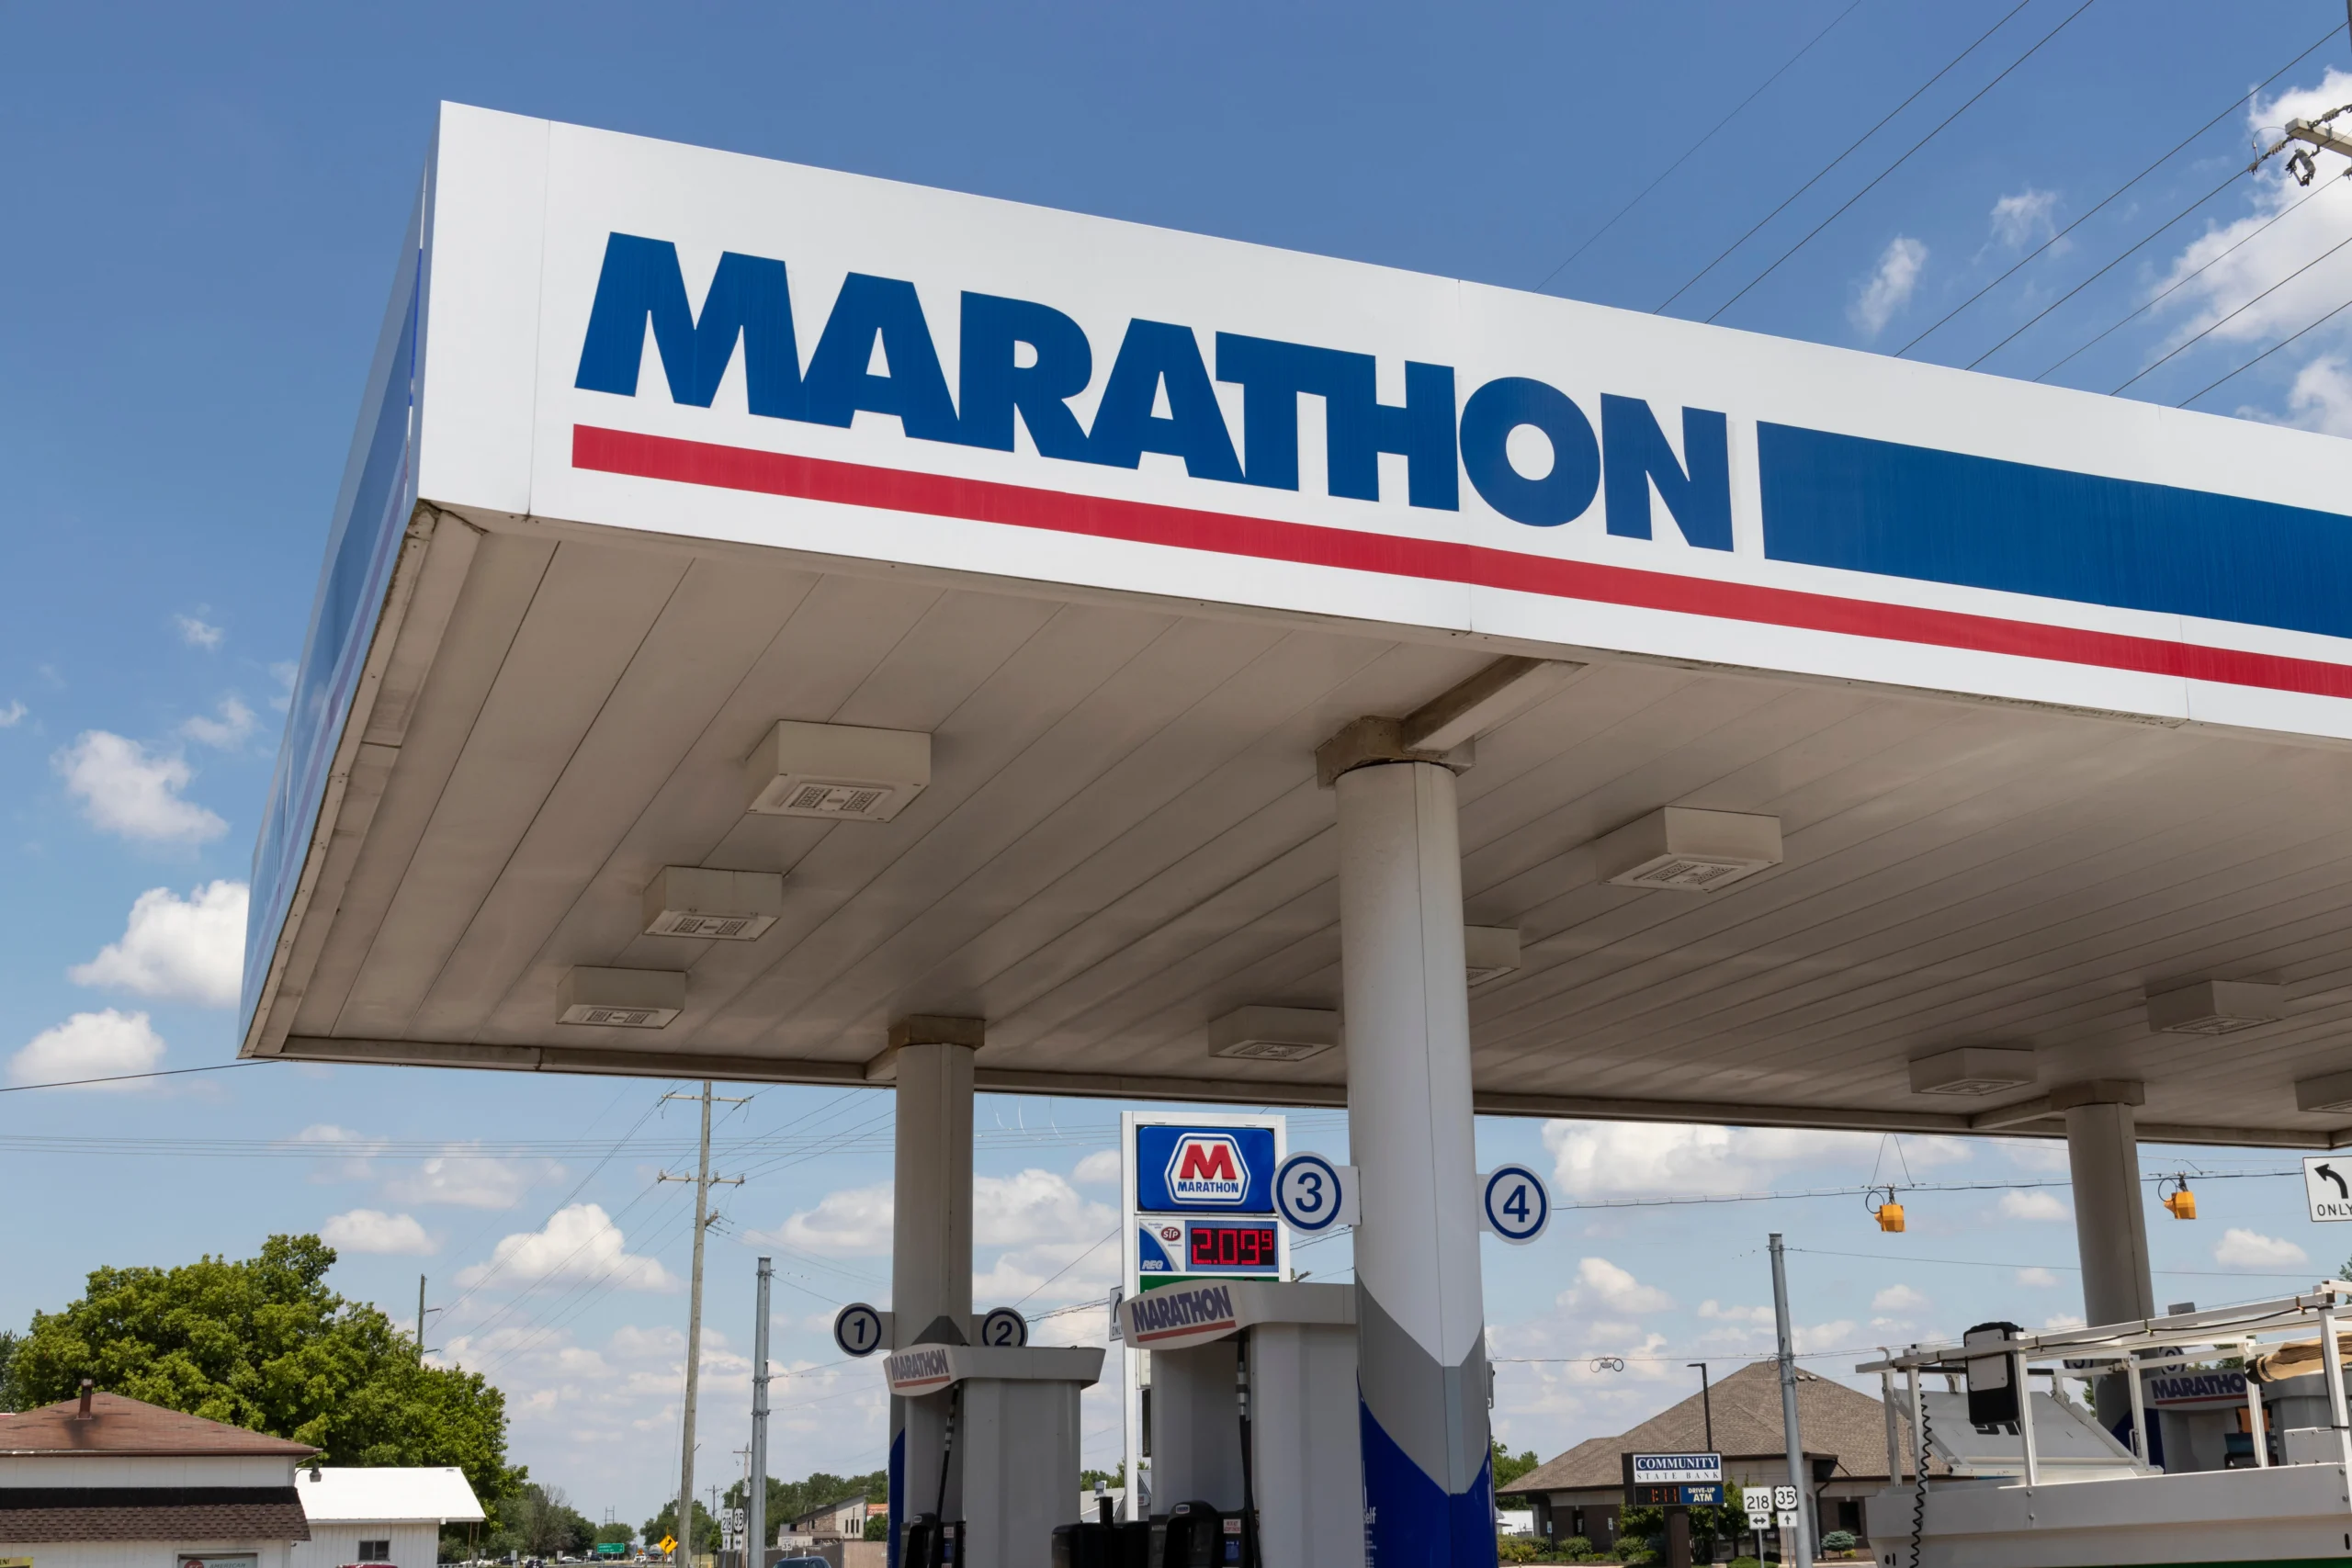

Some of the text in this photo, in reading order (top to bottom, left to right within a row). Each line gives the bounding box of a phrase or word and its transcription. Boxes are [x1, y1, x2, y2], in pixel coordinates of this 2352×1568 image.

[575, 231, 1735, 551] MARATHON
[1179, 1144, 1237, 1180] M
[1177, 1180, 1238, 1193] MARATHON
[1295, 1171, 1323, 1213] 3
[1502, 1184, 1530, 1224] 4
[2317, 1202, 2352, 1217] ONLY
[1162, 1228, 1179, 1239] STP
[1142, 1259, 1164, 1270] REG
[1131, 1285, 1234, 1333] MARATHON
[853, 1317, 865, 1344] 1
[994, 1320, 1013, 1346] 2
[889, 1348, 949, 1381] MARATHON
[2151, 1372, 2263, 1399] MARATHO
[1637, 1457, 1716, 1470] COMMUNITY
[1636, 1472, 1678, 1481] STATE
[1693, 1494, 1713, 1502] ATM
[1747, 1495, 1770, 1509] 218
[1777, 1490, 1795, 1505] 35
[722, 1517, 732, 1531] 218
[735, 1513, 743, 1527] 35
